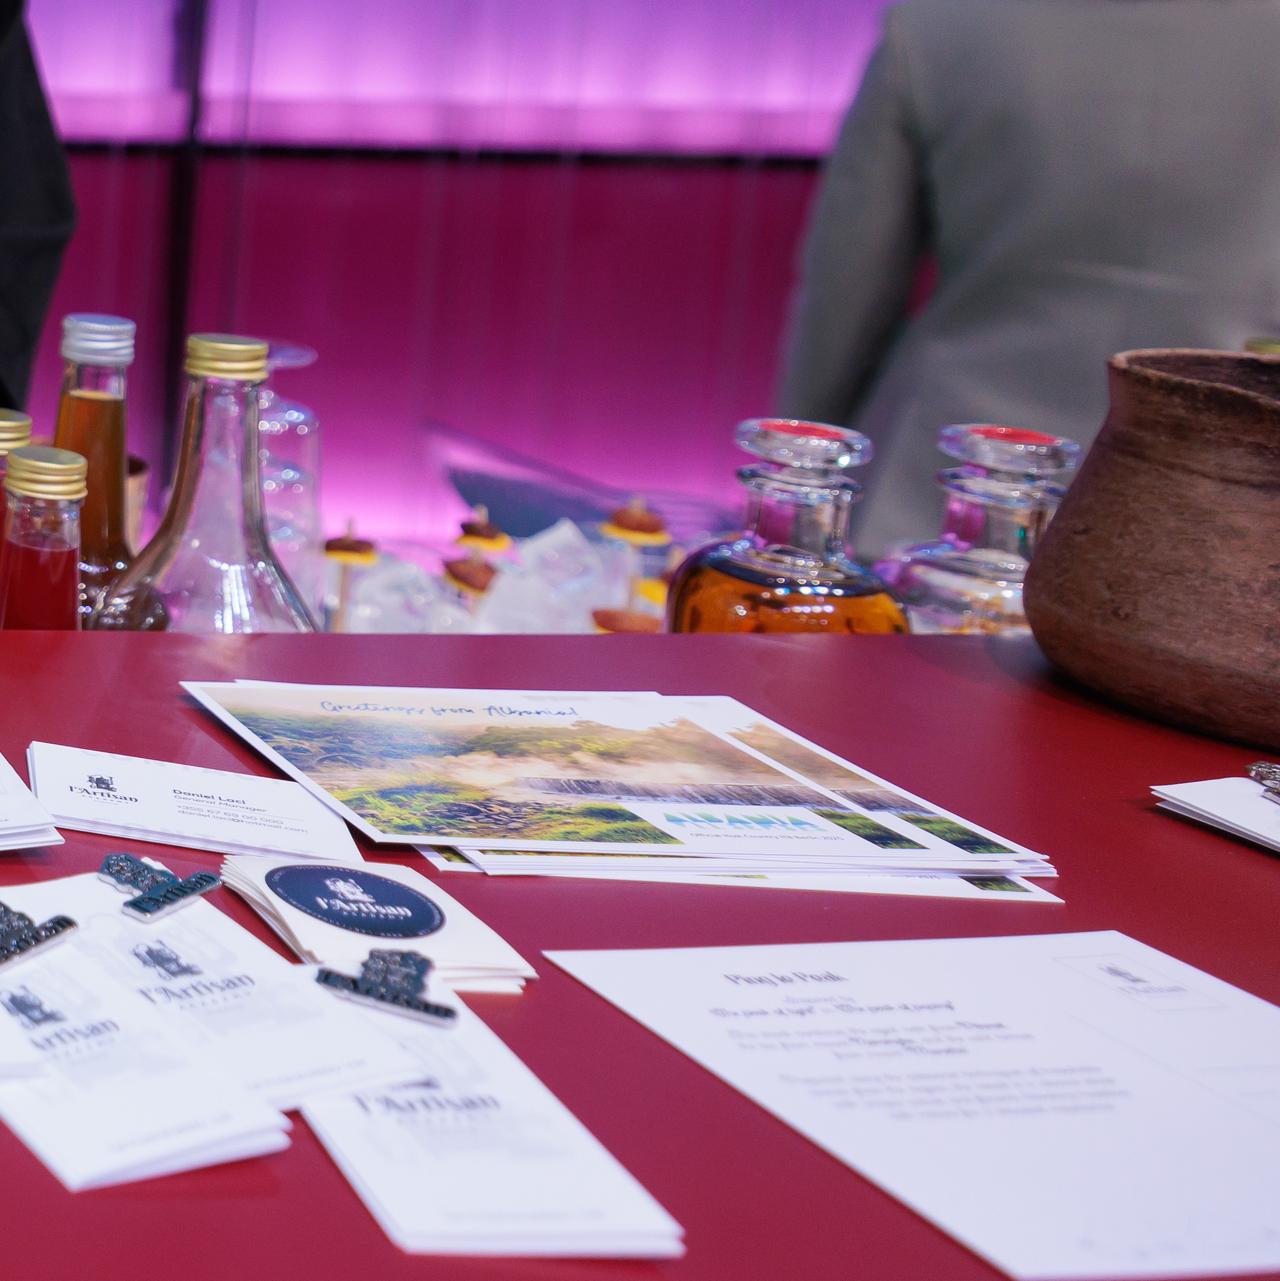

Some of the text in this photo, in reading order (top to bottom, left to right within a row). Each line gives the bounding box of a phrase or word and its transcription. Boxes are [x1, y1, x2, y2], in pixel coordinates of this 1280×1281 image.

[319, 700, 424, 715] Greetings
[430, 705, 475, 717] from
[69, 784, 139, 804] l'Artisan
[172, 789, 215, 800] Daniel
[174, 795, 268, 812] General Manager
[316, 896, 413, 918] l'Artisan
[137, 973, 255, 1005] l'Artisan
